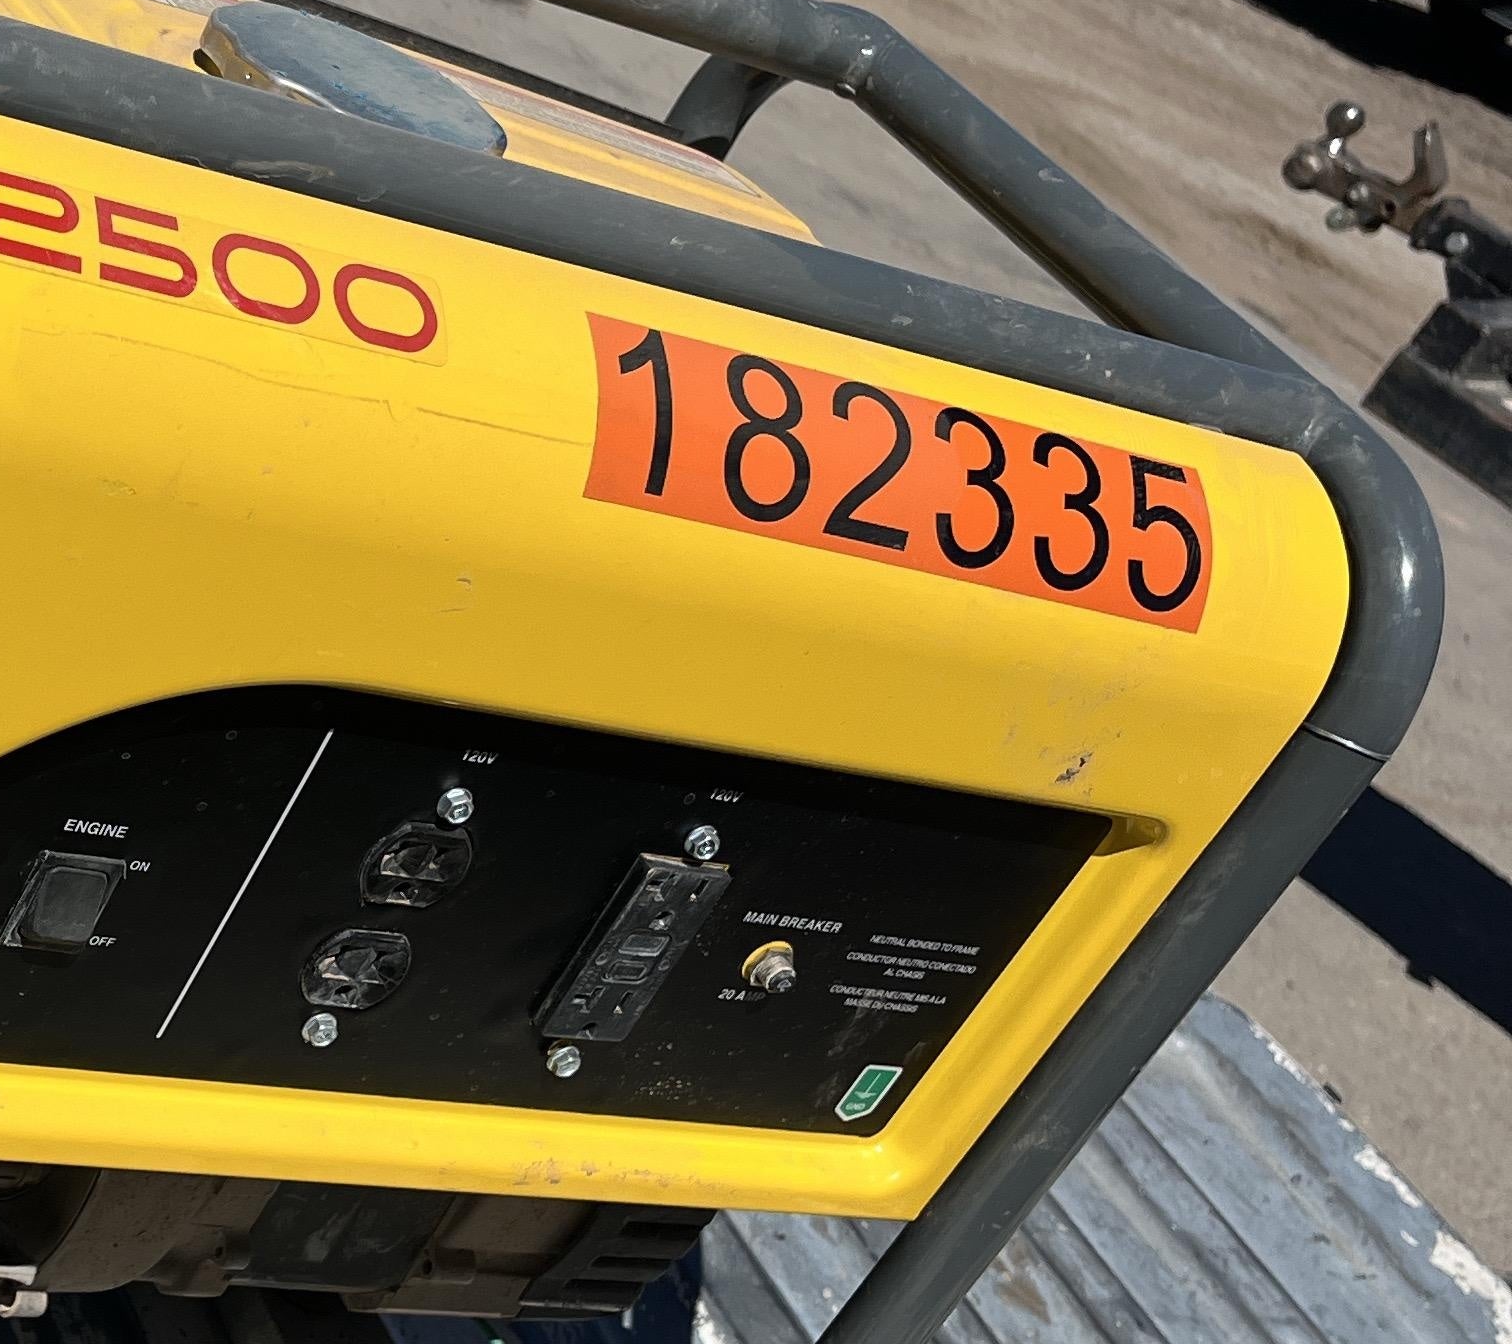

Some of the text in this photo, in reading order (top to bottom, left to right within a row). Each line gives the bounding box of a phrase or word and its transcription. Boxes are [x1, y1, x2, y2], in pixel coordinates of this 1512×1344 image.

[618, 329, 1203, 612] 182335
[462, 749, 499, 765] 120V
[709, 787, 744, 803] 120V
[63, 818, 129, 839] ENGINE
[129, 860, 151, 872] ON
[742, 911, 844, 934] MAIN BREAKER
[89, 935, 117, 947] OFF
[869, 934, 906, 947] NEUTRAL
[941, 943, 952, 953] TO
[846, 952, 897, 965] CONDUCTOR
[718, 988, 736, 1000] 20
